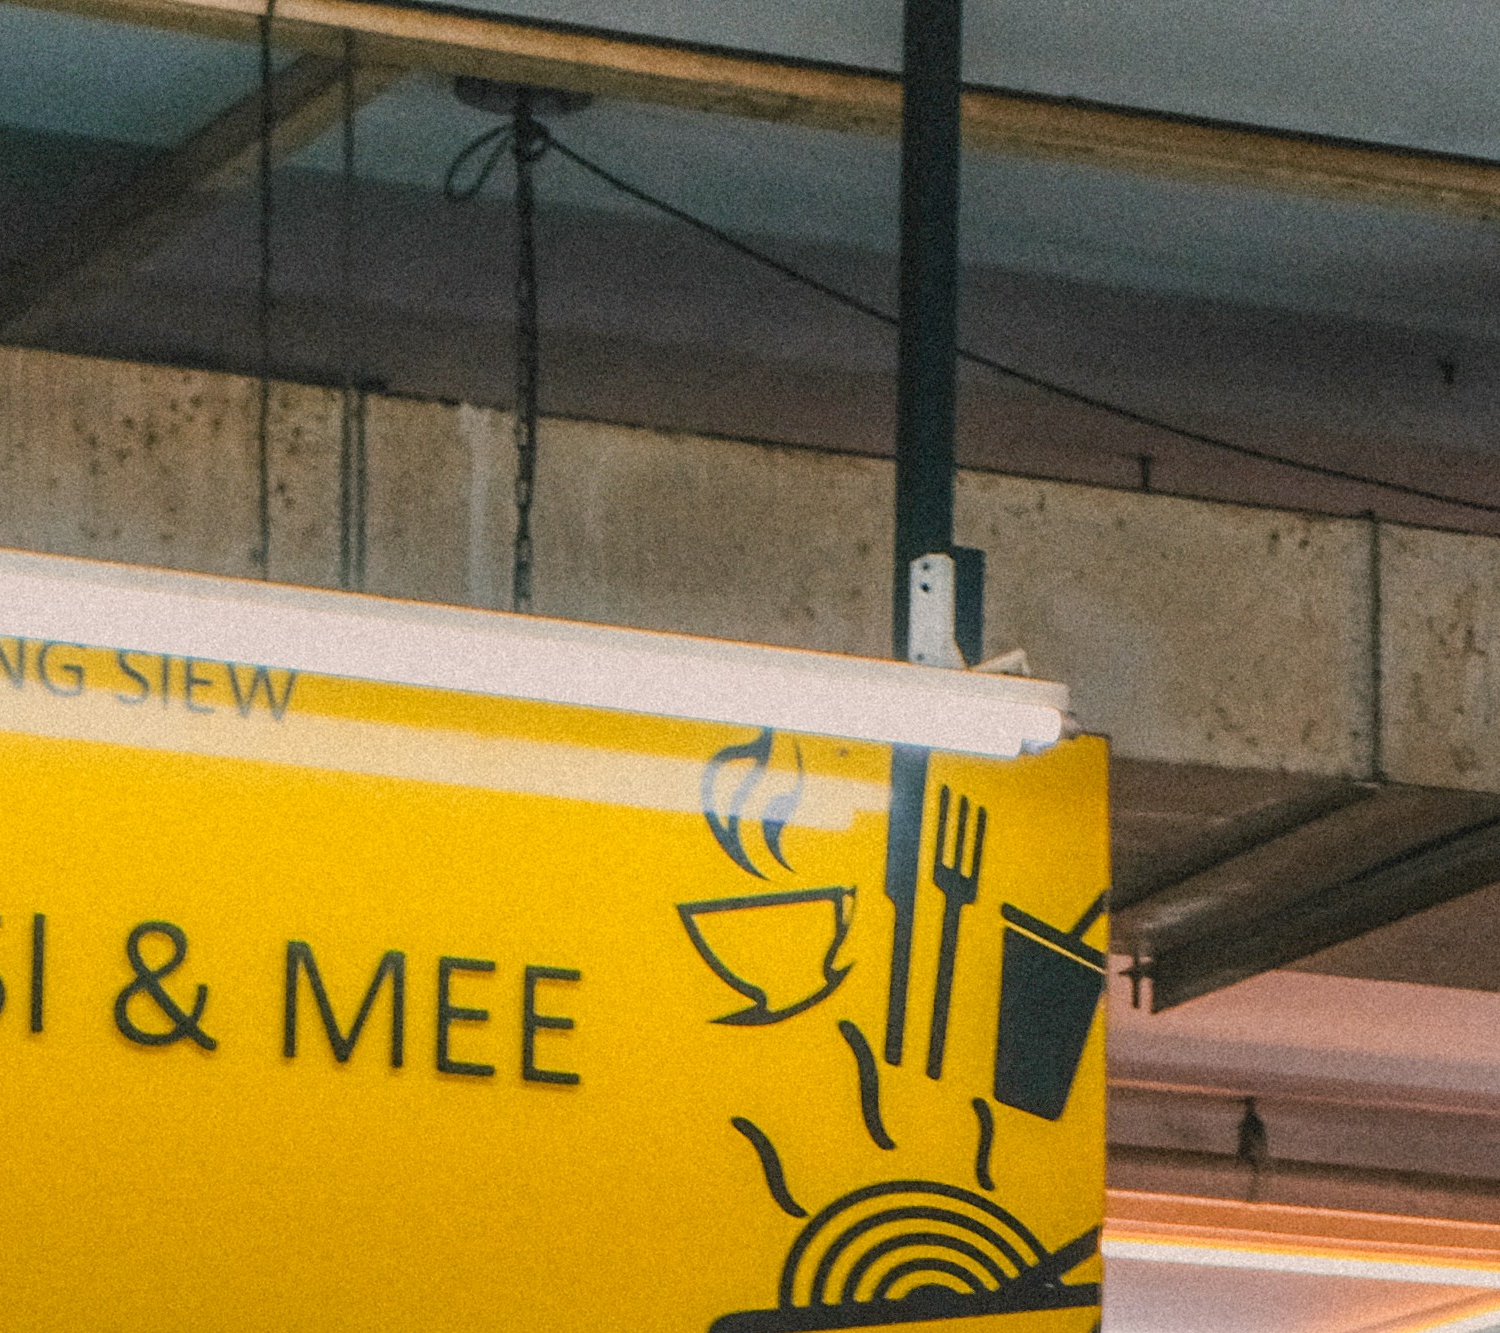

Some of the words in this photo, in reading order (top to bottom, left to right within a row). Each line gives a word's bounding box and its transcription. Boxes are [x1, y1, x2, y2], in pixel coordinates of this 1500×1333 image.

[114, 645, 298, 722] SIEW
[112, 920, 218, 1053] &
[282, 939, 582, 1087] MEE
